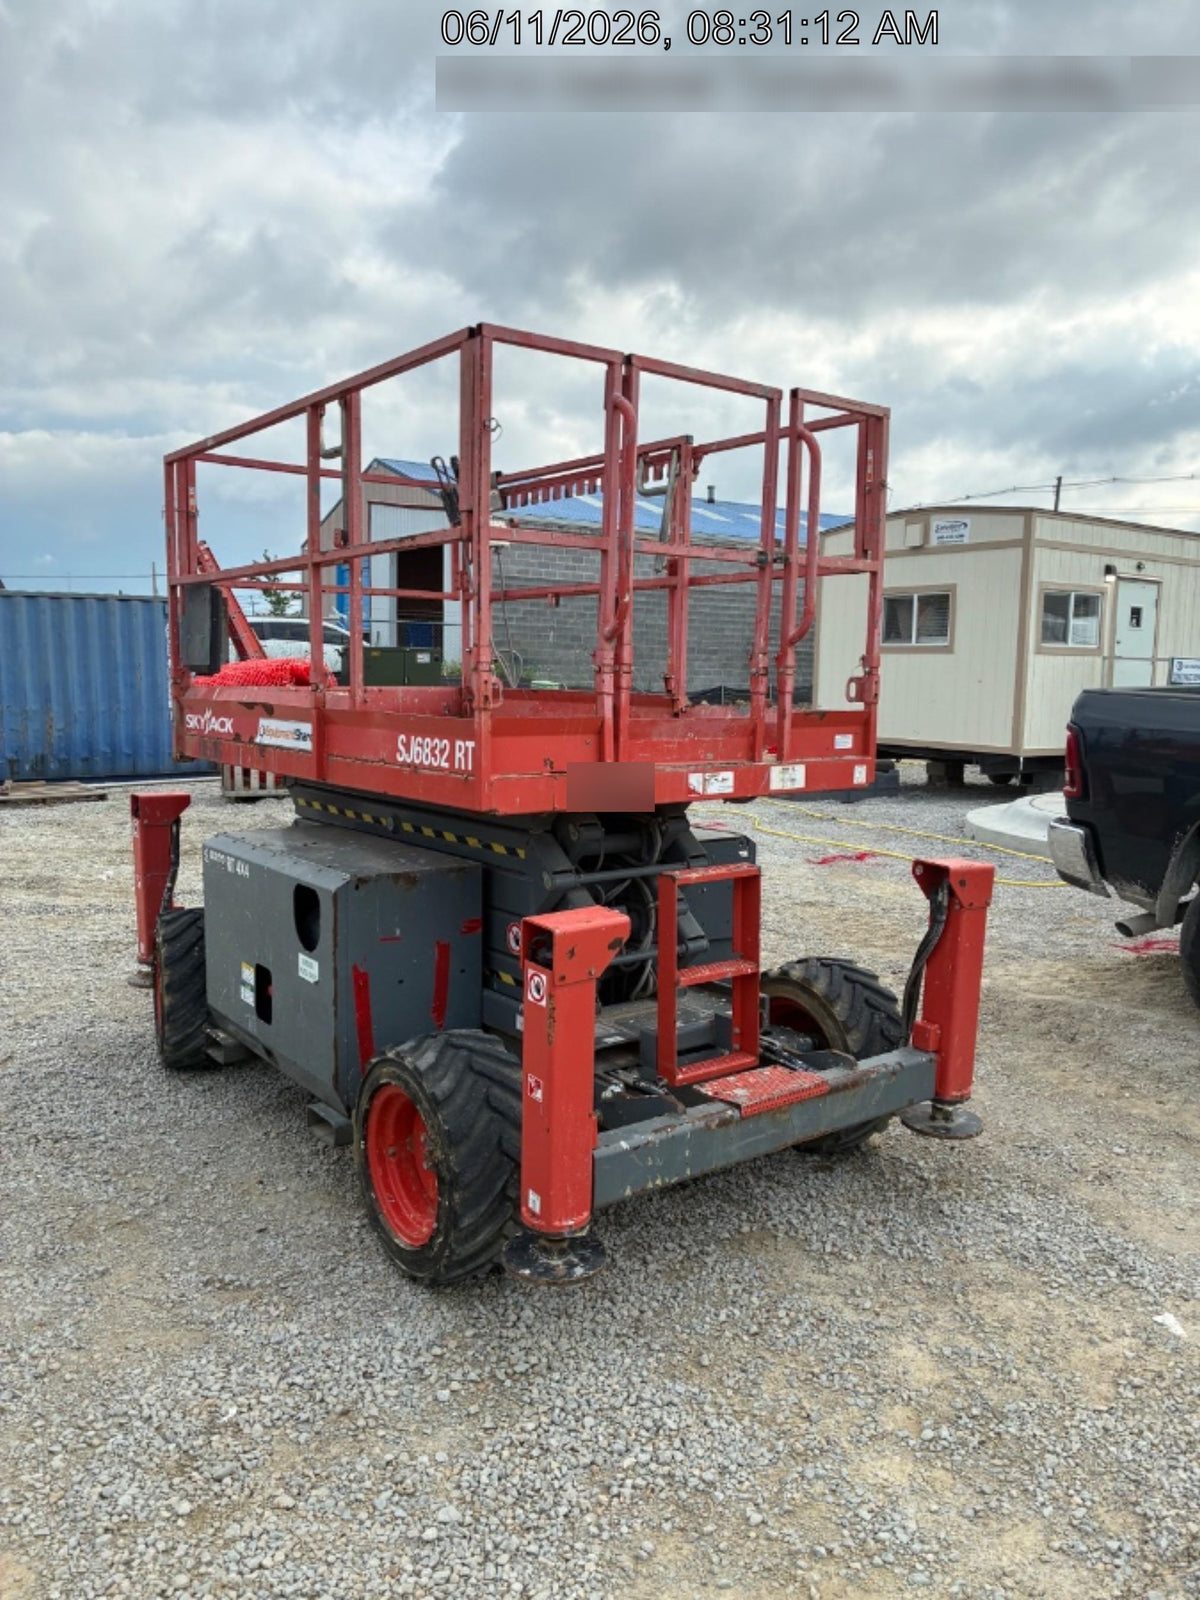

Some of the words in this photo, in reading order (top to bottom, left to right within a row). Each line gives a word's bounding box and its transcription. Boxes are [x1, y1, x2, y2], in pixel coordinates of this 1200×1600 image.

[185, 708, 234, 734] SKYJACK
[396, 734, 450, 768] SJ6832
[455, 740, 475, 770] RT
